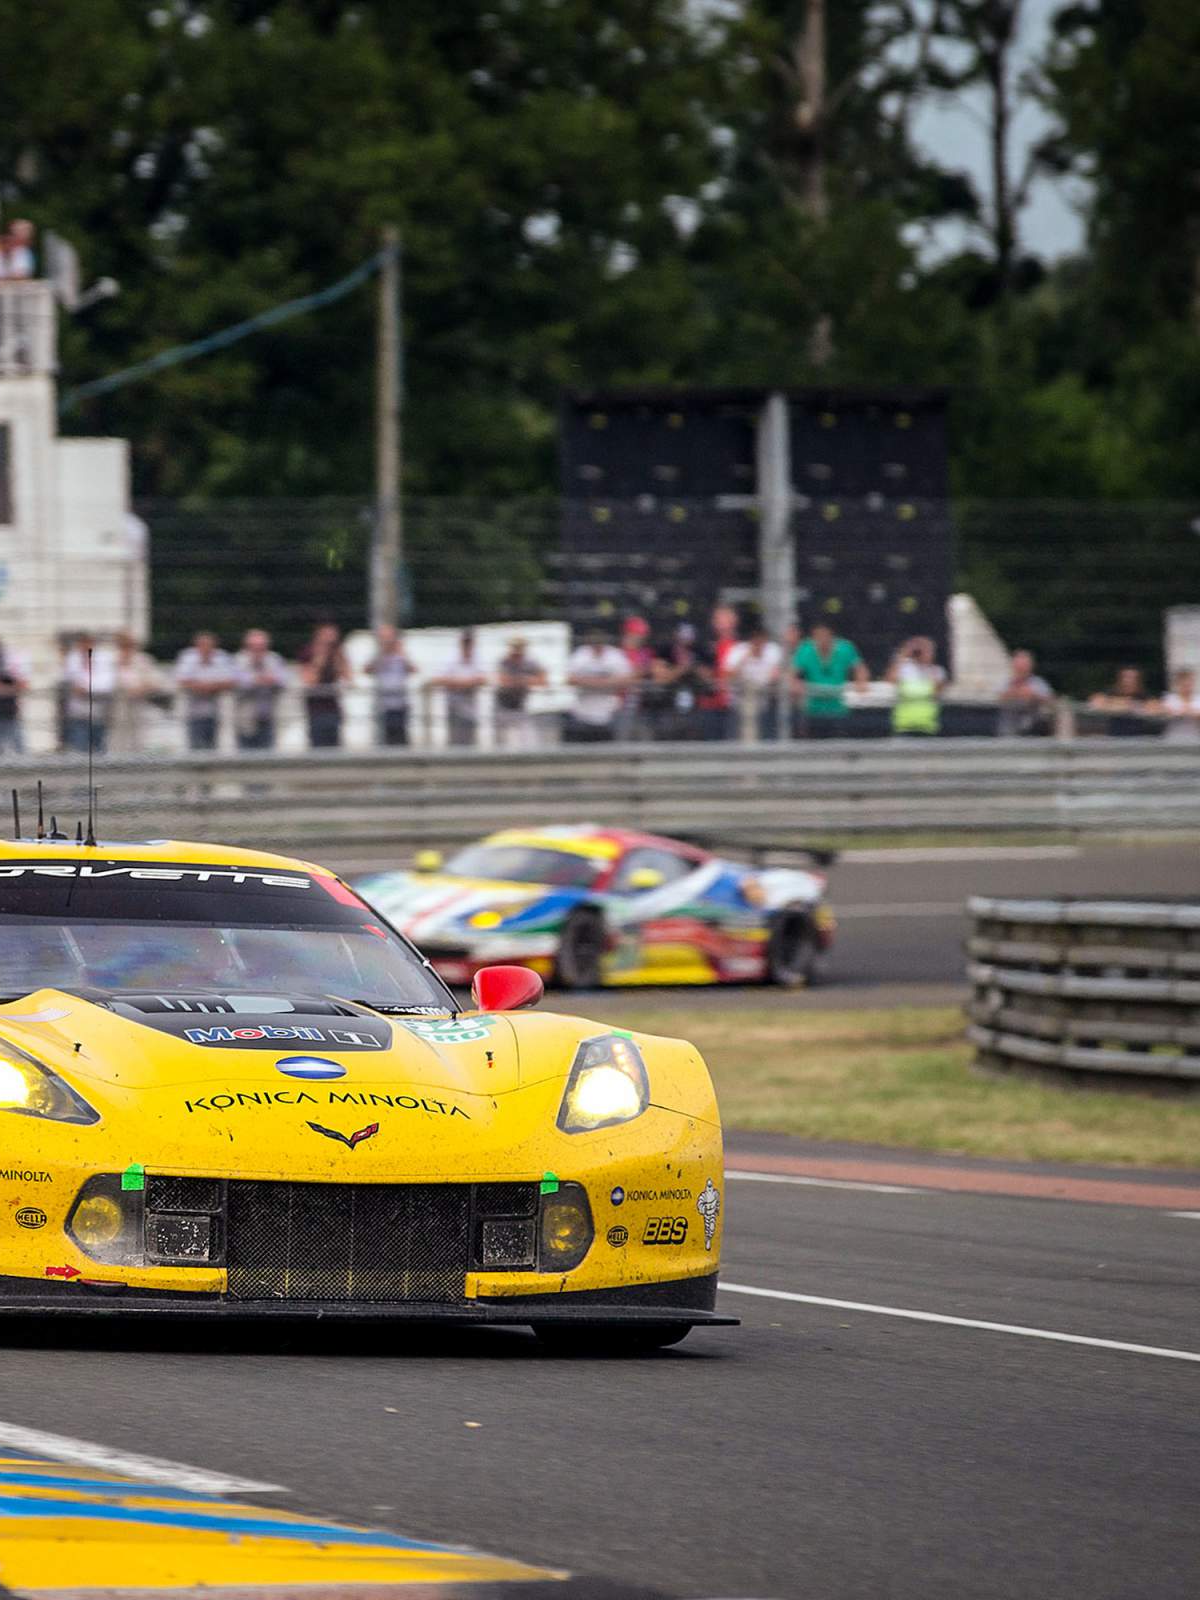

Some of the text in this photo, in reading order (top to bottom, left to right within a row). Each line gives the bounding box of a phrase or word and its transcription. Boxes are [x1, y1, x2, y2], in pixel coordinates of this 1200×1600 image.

[183, 1025, 326, 1044] Mobil
[185, 1091, 471, 1120] KONICA MINOLTA
[626, 1188, 693, 1201] KONICA MINOLTA
[642, 1216, 689, 1246] BBS
